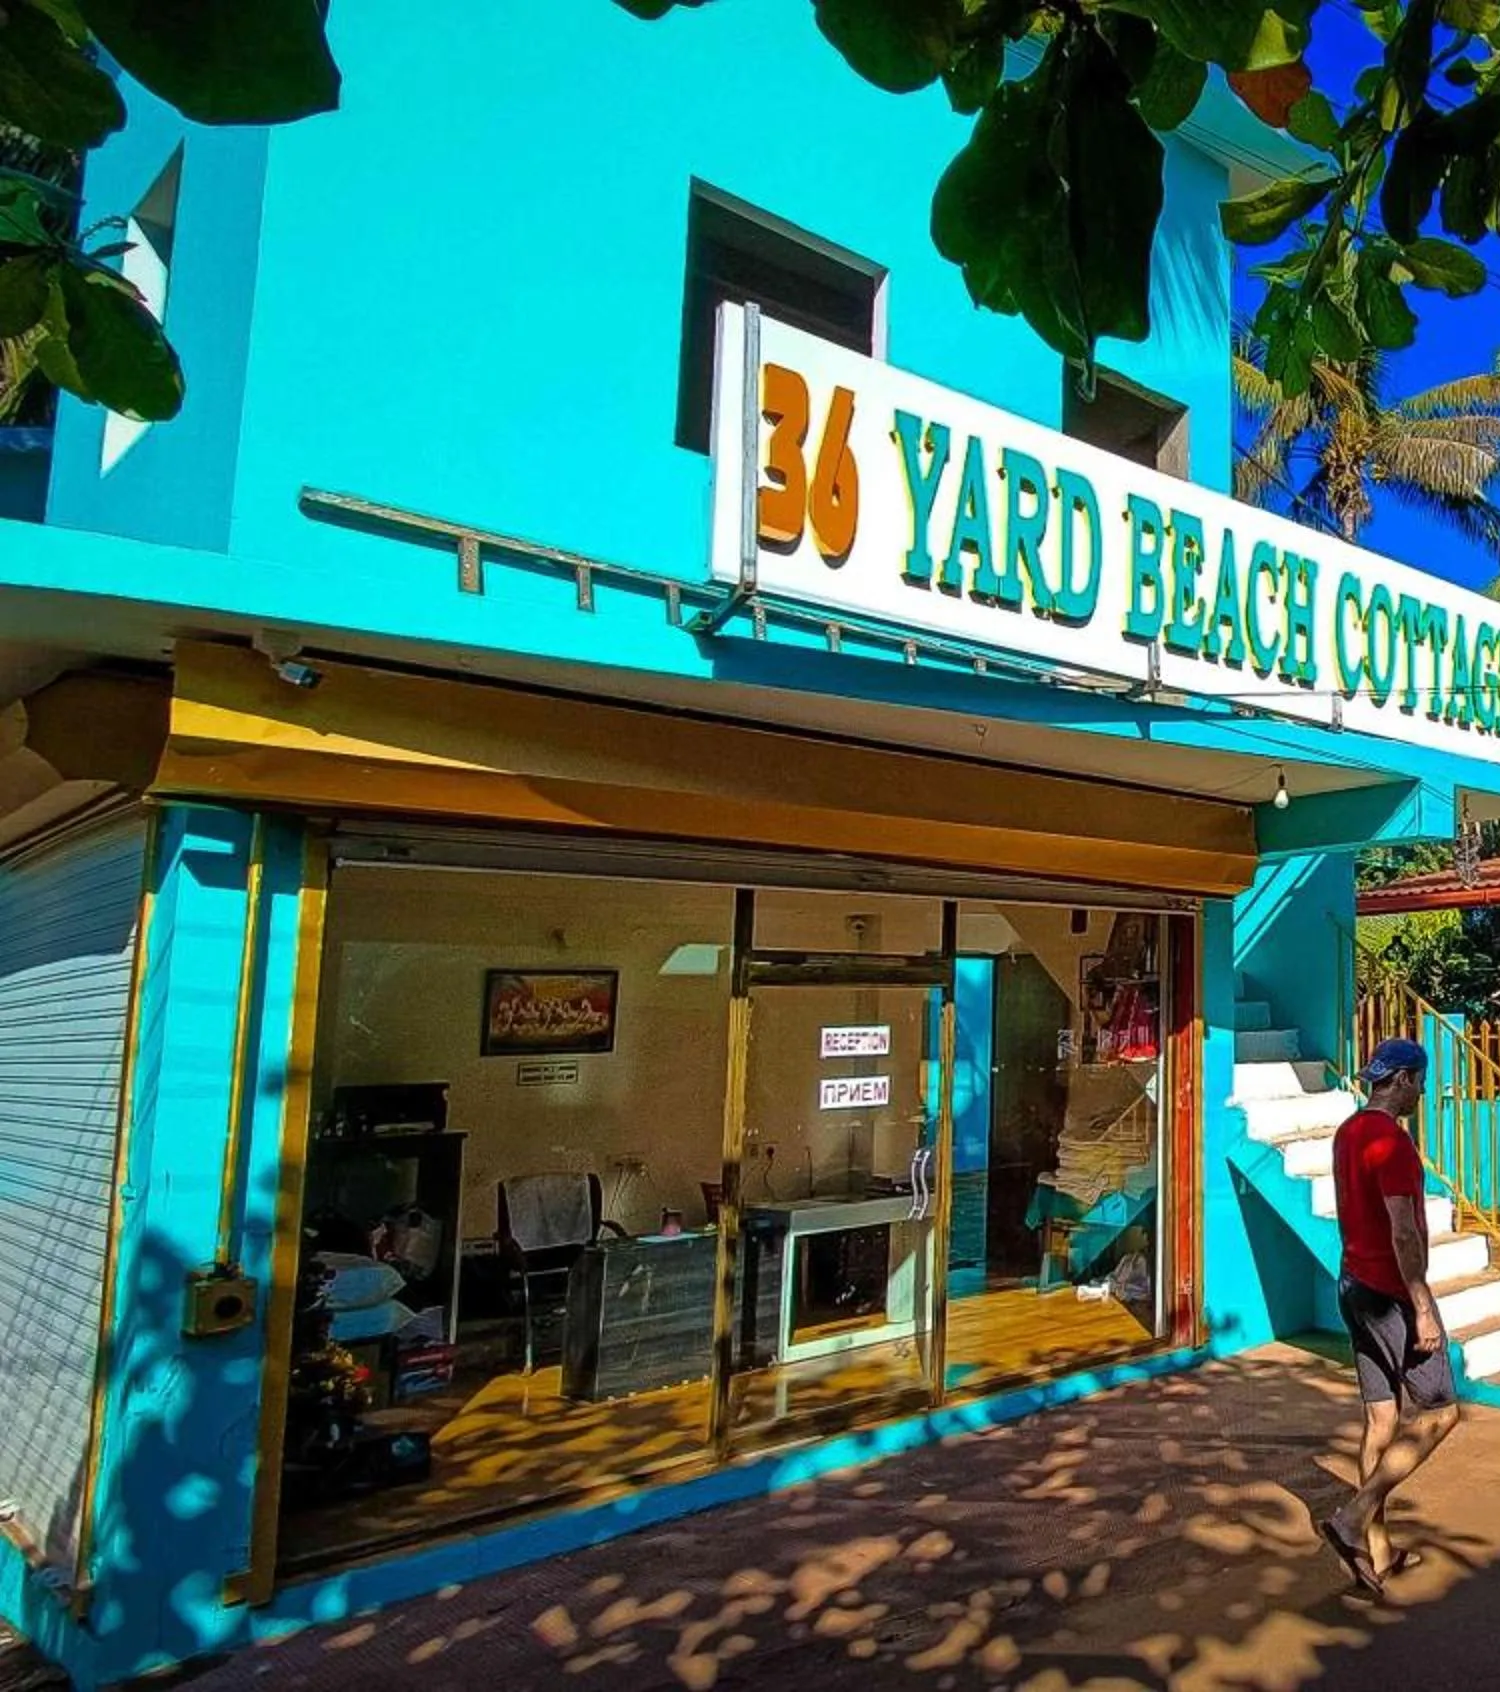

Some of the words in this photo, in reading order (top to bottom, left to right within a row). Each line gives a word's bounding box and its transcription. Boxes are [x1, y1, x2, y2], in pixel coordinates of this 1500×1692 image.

[759, 362, 860, 562] 36
[890, 408, 1102, 628] YARD
[1122, 493, 1319, 688] BEACH
[824, 1031, 887, 1051] RECEPTION
[824, 1082, 887, 1104] ПРИЕМ
